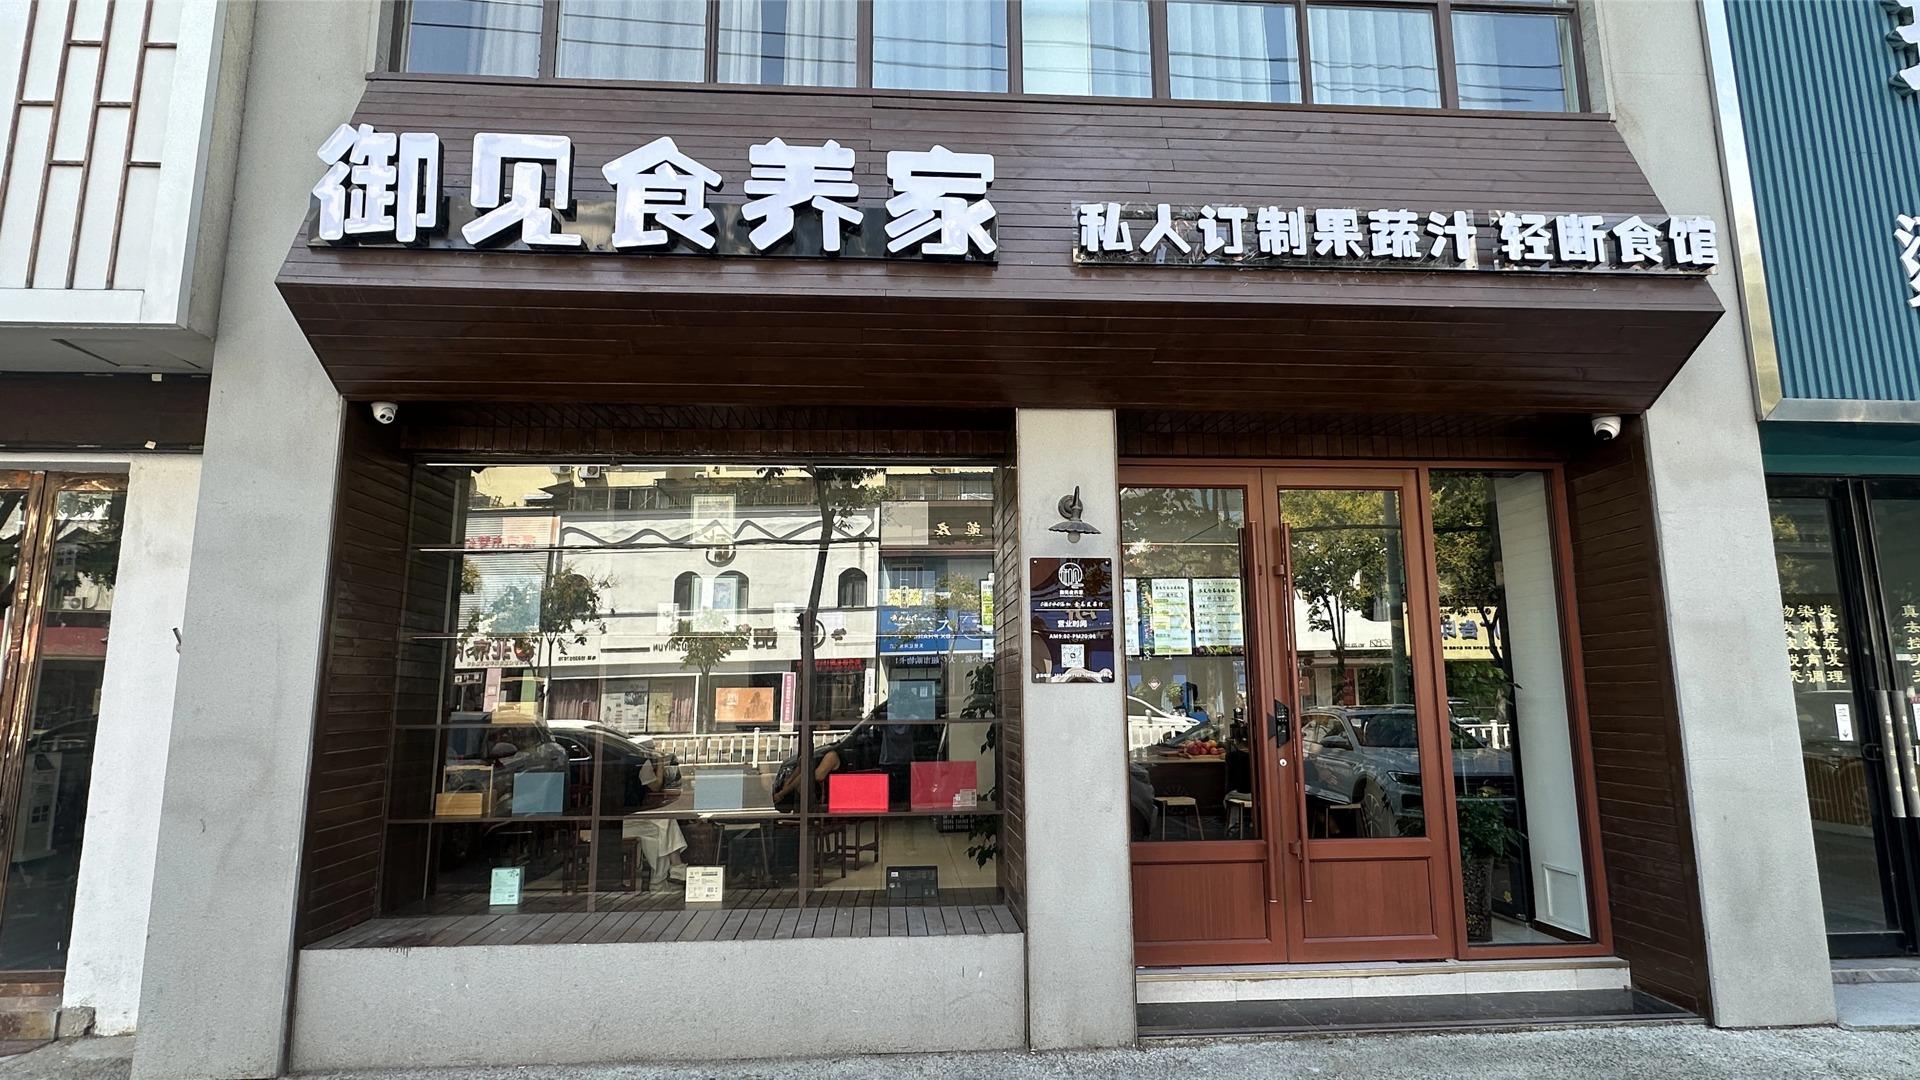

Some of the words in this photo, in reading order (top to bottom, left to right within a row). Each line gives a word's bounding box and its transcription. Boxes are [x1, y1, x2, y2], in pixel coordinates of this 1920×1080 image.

[314, 123, 1000, 258] 御见食养家
[1077, 202, 1478, 264] 私人订制果蔬汁
[1495, 210, 1720, 268] 轻断食馆
[1057, 619, 1088, 628] 营业时间
